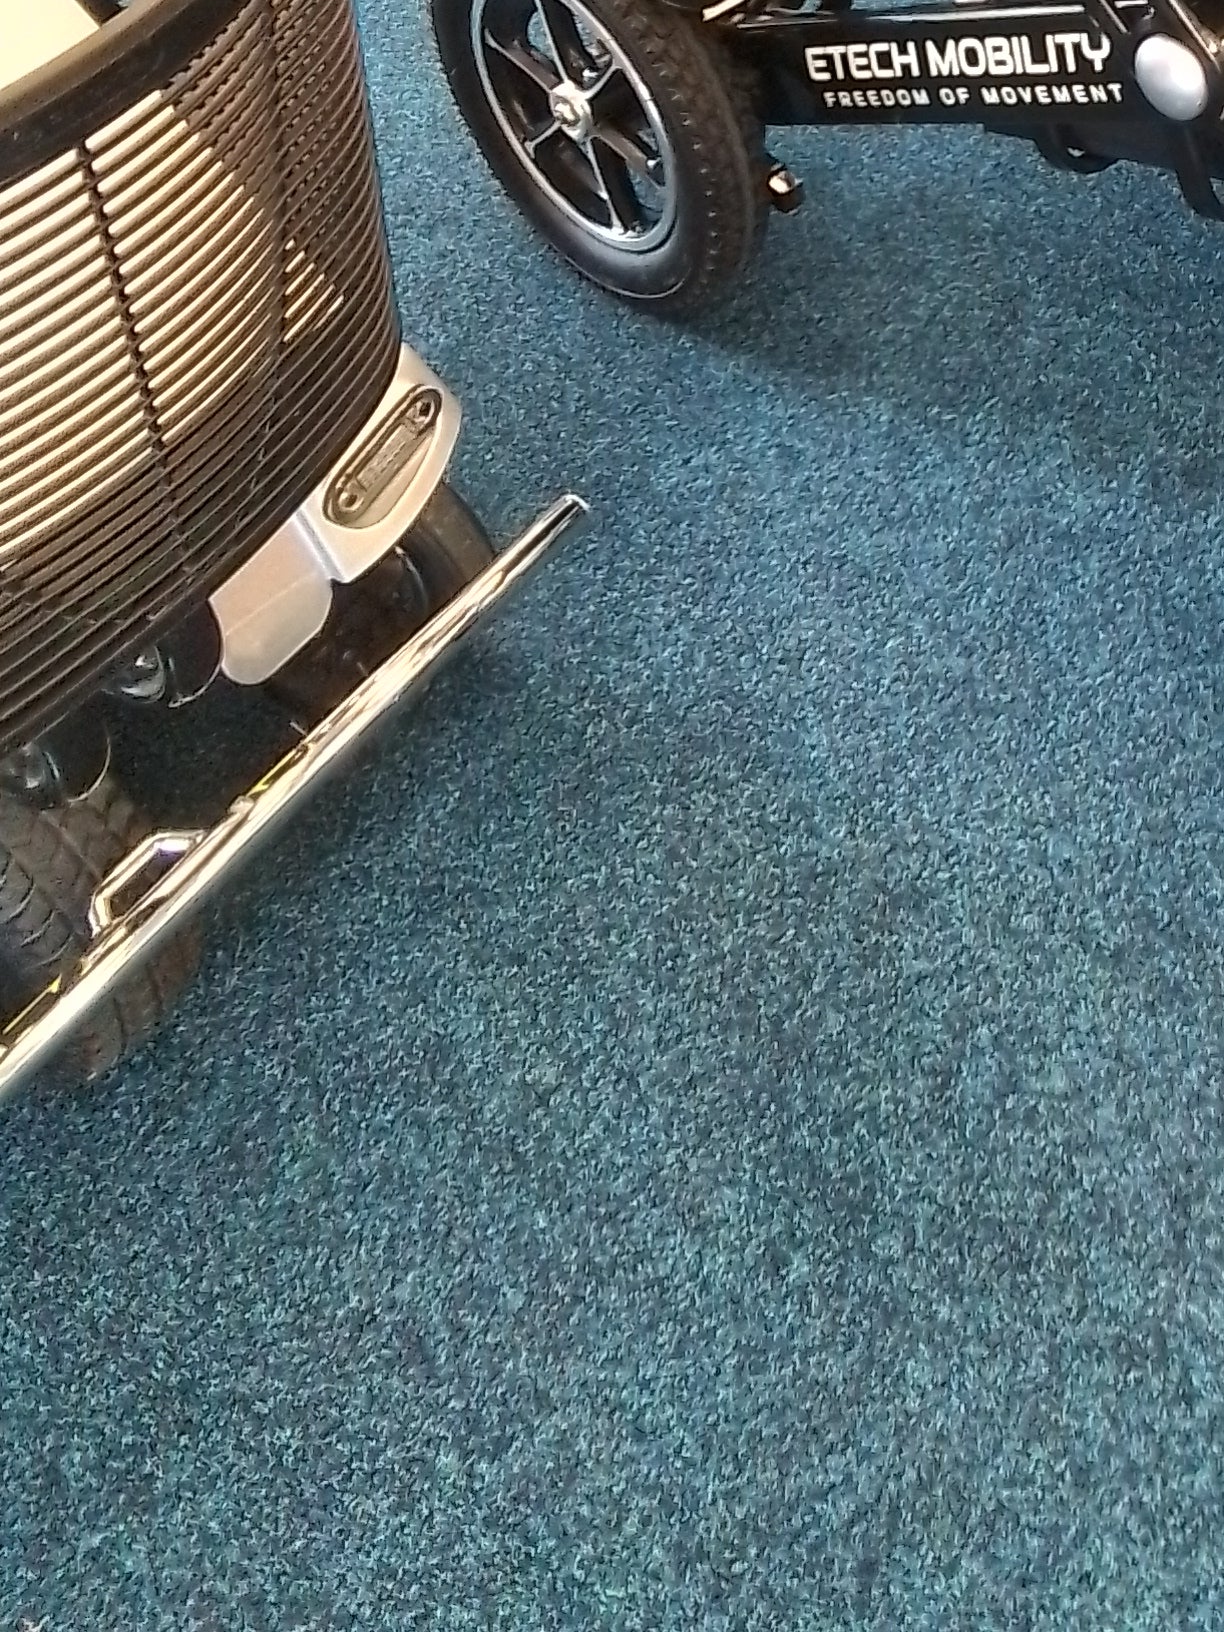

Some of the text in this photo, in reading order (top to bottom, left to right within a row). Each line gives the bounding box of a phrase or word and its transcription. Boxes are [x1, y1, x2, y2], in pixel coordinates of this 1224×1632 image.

[804, 31, 1111, 82] ETECH MOBILITY
[822, 82, 1124, 109] FREEDOM OF MOVEMENT
